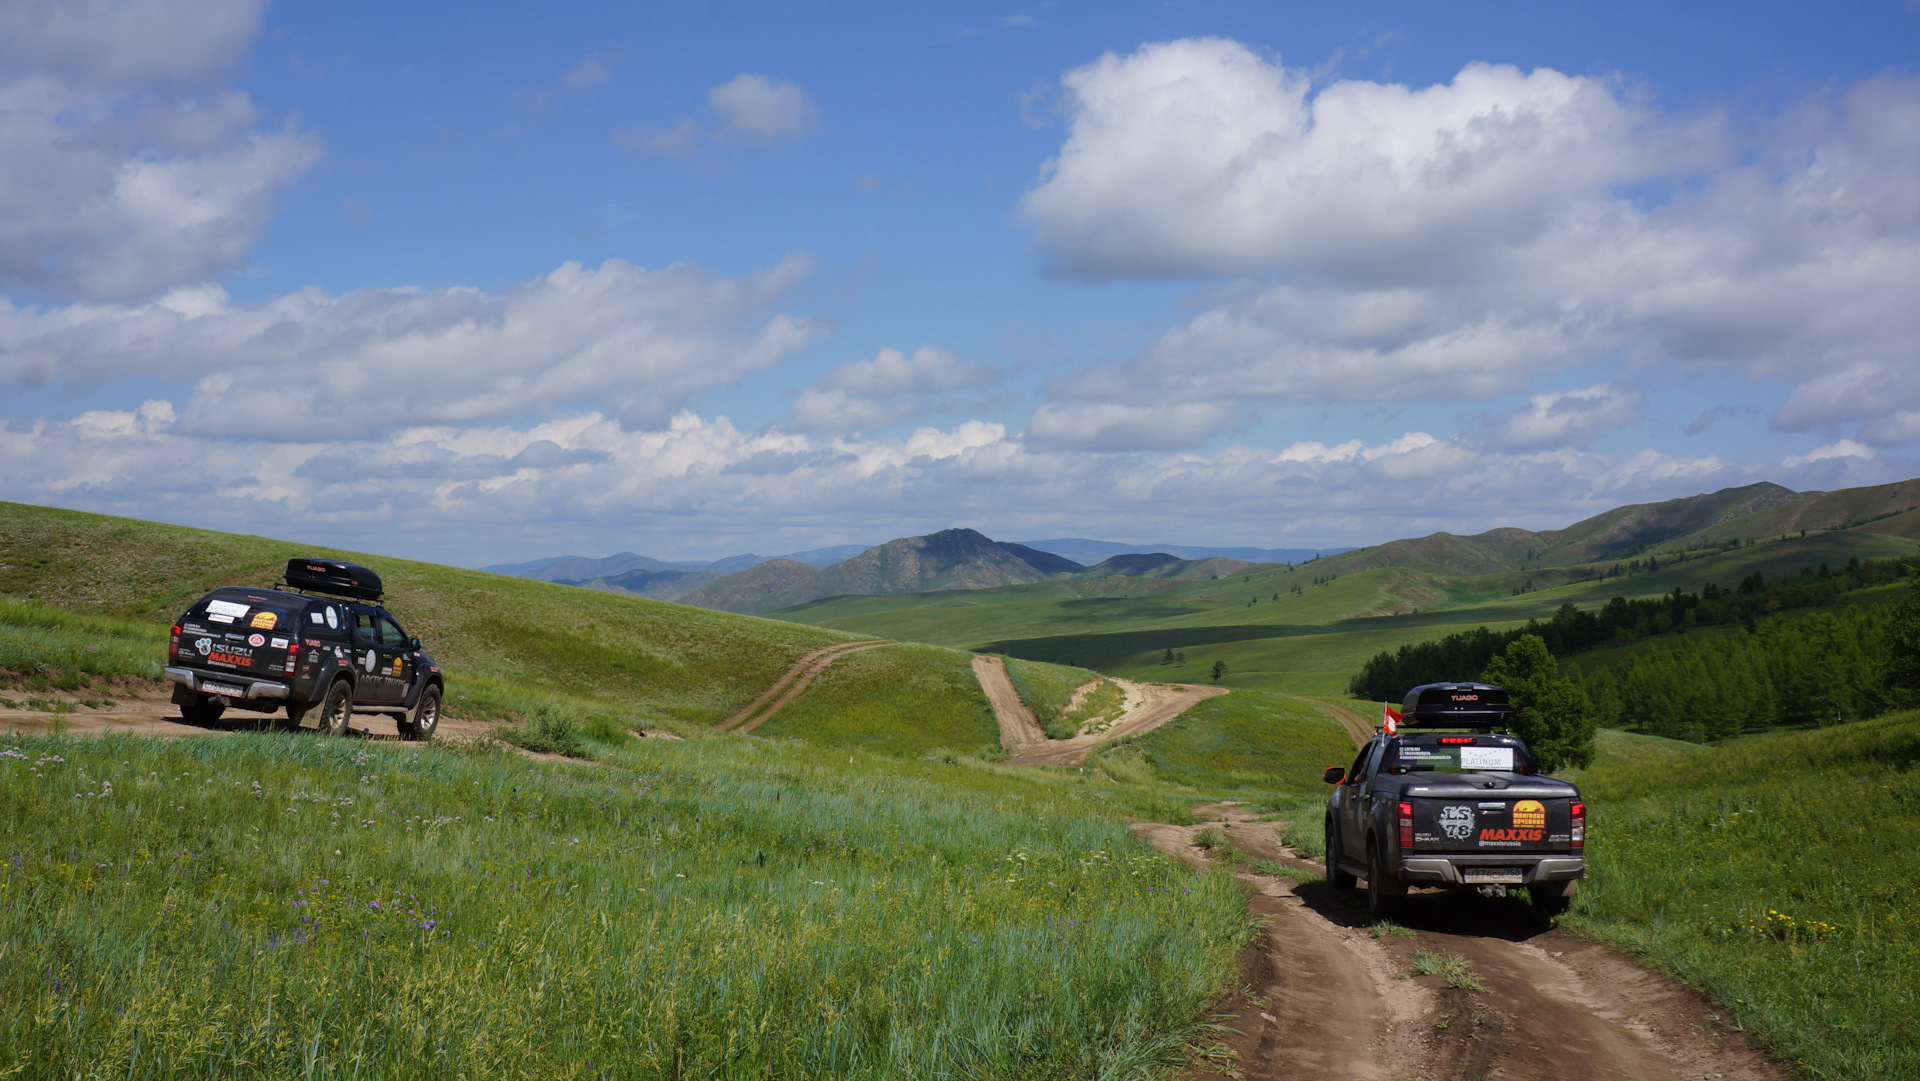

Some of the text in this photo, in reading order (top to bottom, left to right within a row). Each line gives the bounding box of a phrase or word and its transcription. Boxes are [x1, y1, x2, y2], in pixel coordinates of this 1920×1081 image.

[211, 643, 253, 657] ISUZU
[208, 652, 252, 667] MAXXIS
[360, 674, 383, 685] ARCTIC
[1460, 758, 1501, 766] PLATINUM
[1445, 808, 1470, 820] LS
[1446, 825, 1469, 837] 78
[1479, 829, 1543, 841] MAXXIS
